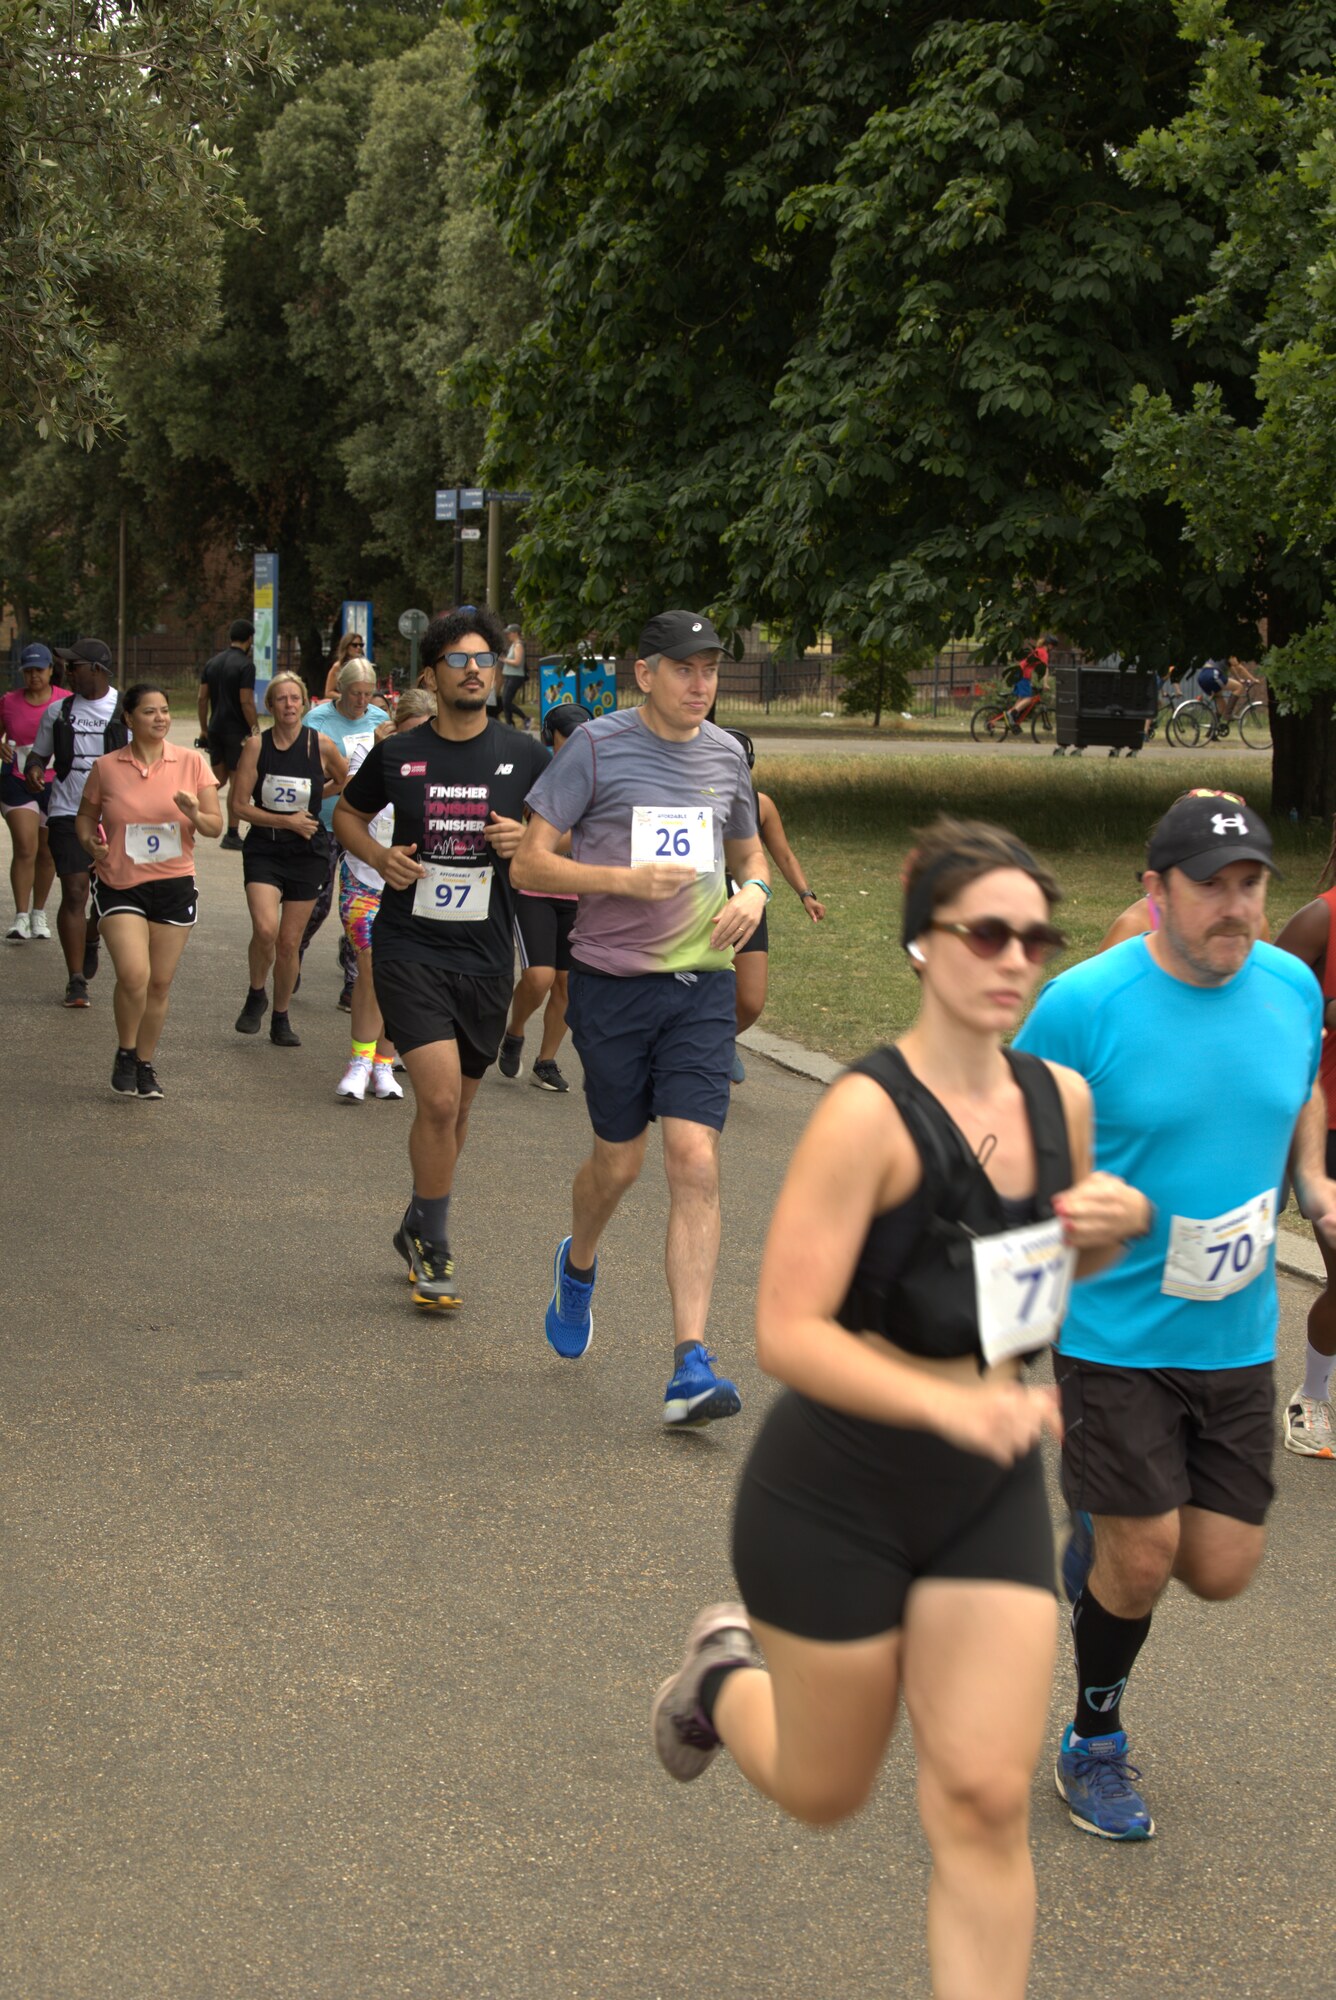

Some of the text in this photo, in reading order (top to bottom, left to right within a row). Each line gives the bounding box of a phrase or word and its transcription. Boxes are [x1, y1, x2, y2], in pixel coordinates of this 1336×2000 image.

[273, 787, 297, 803] 25
[429, 786, 488, 799] FINISHER
[428, 802, 488, 815] FINISHER
[428, 820, 486, 832] FINISHER
[146, 834, 160, 853] 9
[655, 828, 691, 857] 26
[435, 884, 472, 909] 97
[1205, 1233, 1253, 1281] 70
